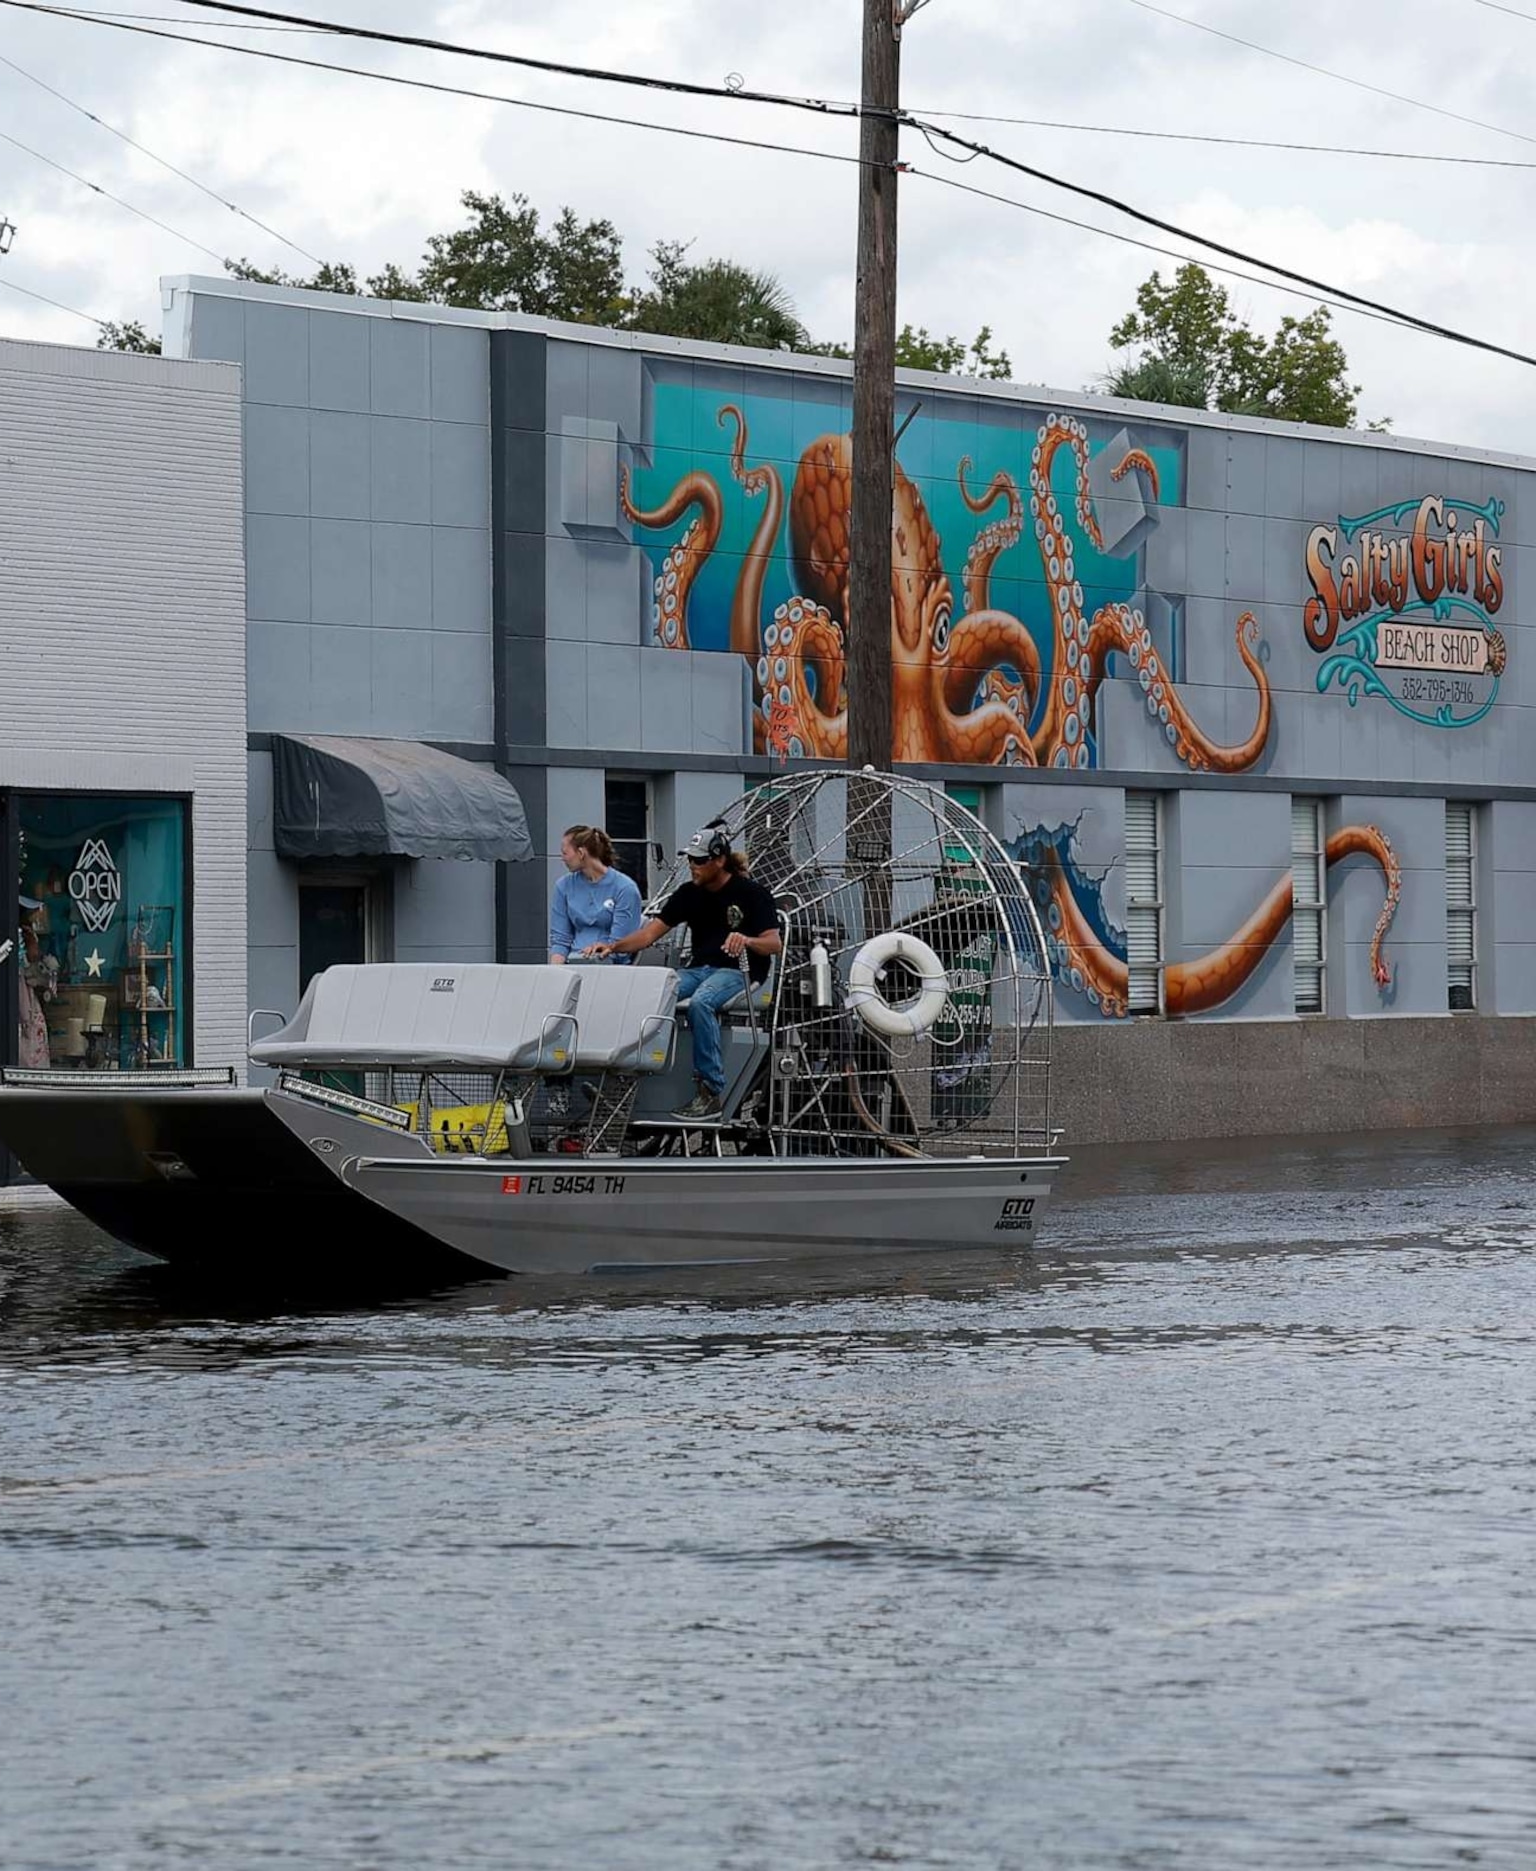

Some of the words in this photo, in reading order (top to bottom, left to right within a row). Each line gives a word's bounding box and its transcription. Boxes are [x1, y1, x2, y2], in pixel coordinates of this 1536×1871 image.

[1304, 524, 1409, 652] Salty
[1411, 495, 1503, 614] Girls
[1384, 629, 1435, 662] BEACH
[1441, 634, 1479, 666] SHOP
[1402, 678, 1474, 704] 352-795-1346
[68, 871, 121, 900] OPEN
[434, 978, 454, 986] GTO
[527, 1176, 545, 1194] FL
[552, 1176, 595, 1194] 9454
[603, 1176, 625, 1194] TH
[1002, 1199, 1035, 1214] GTO
